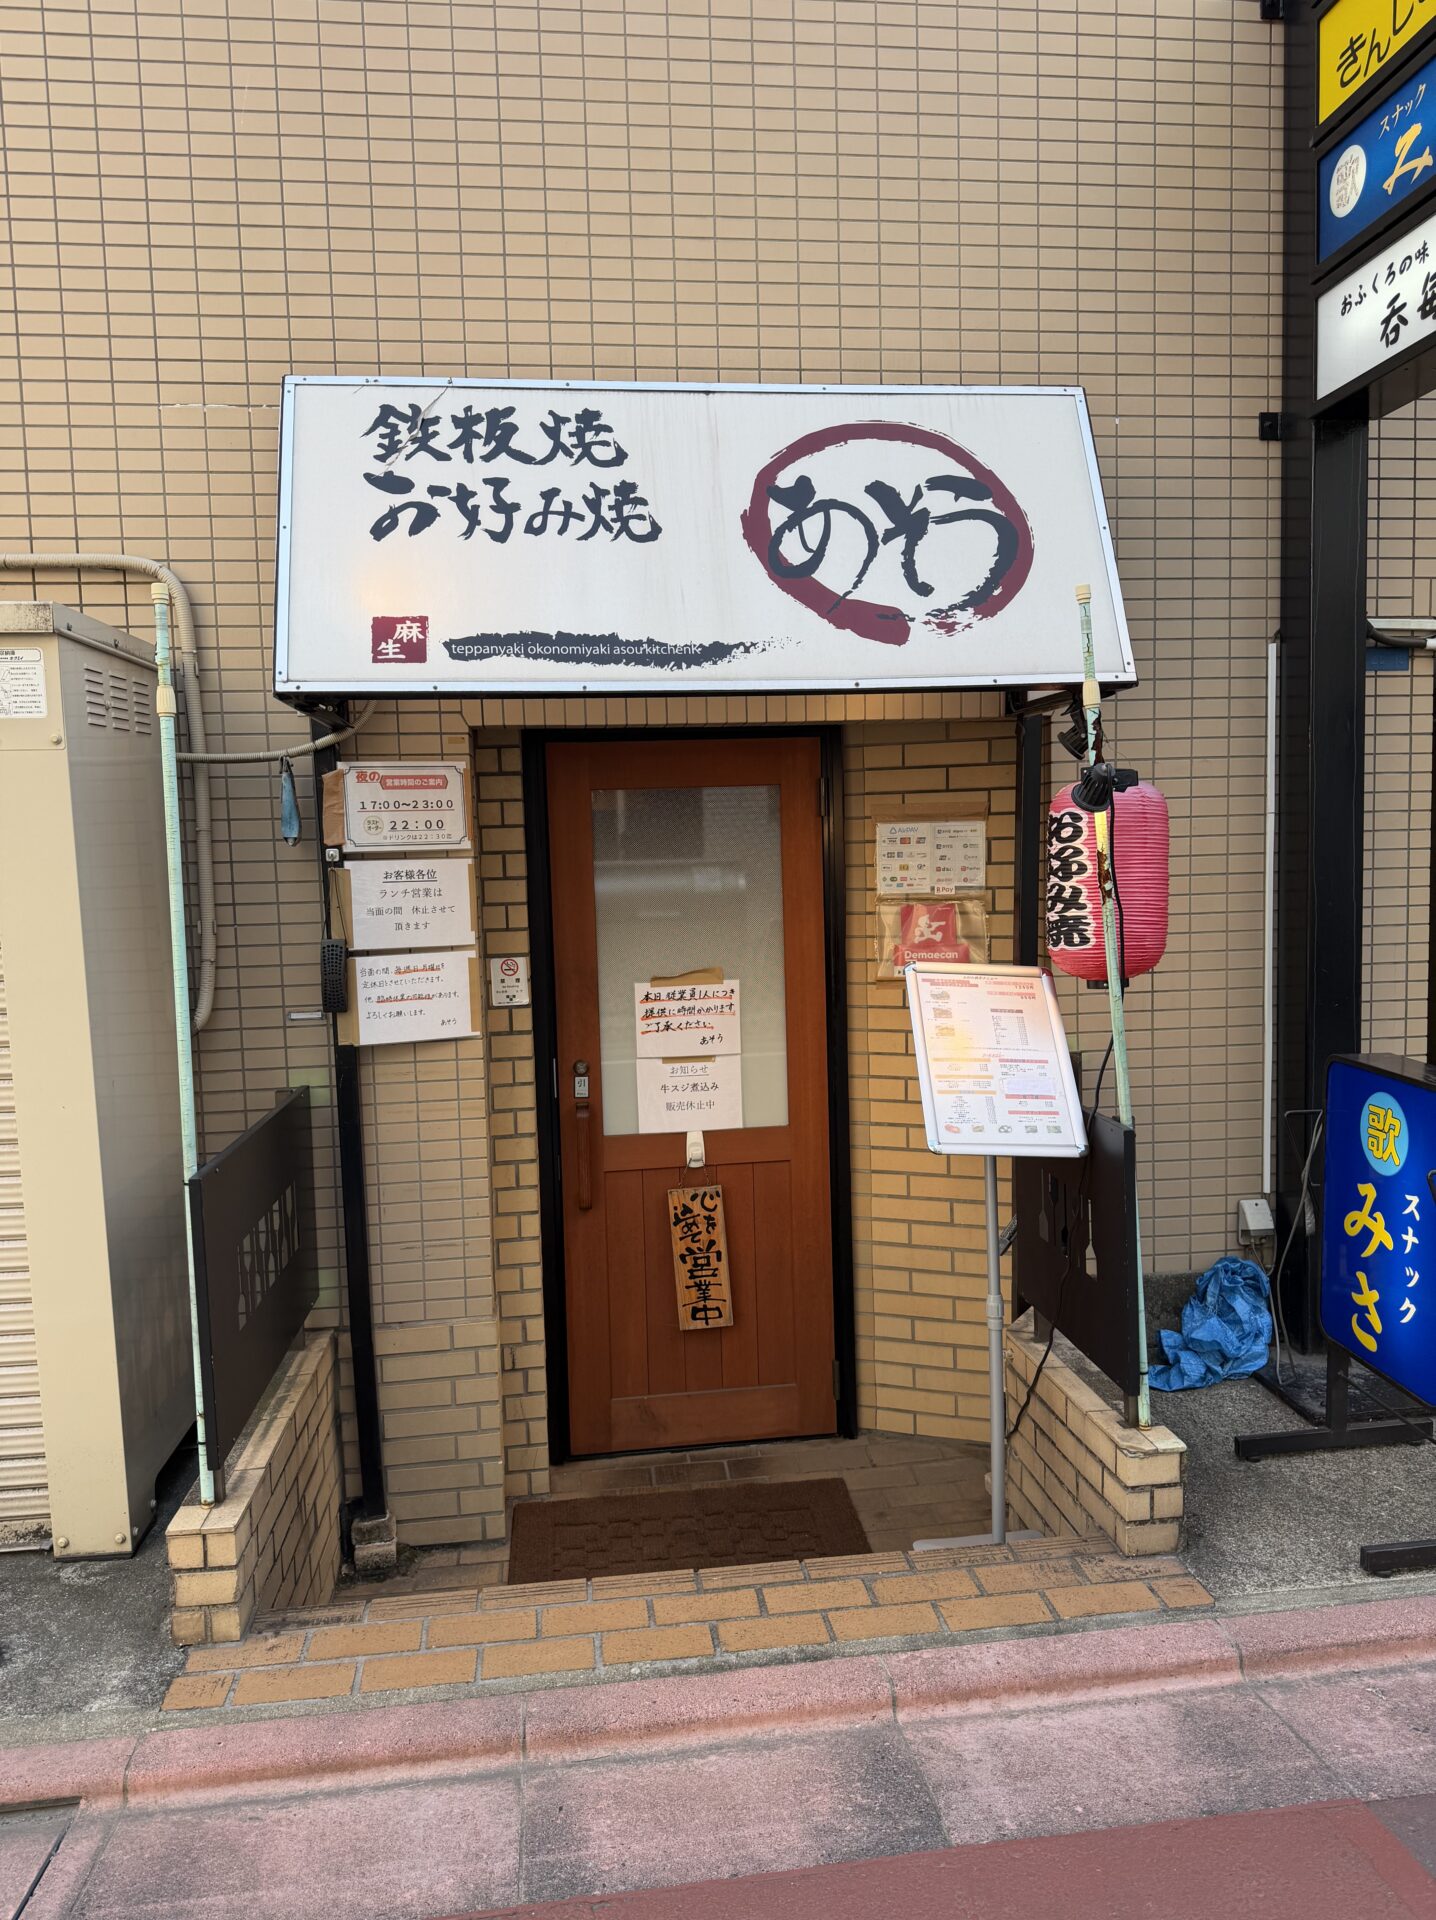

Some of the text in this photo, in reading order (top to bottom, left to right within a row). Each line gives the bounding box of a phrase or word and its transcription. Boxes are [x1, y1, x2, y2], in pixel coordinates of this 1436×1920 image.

[1378, 83, 1427, 140] スナック
[1340, 239, 1430, 317] おふくろの味
[360, 403, 629, 468] 鉄板焼
[362, 470, 663, 544] お好み焼
[765, 474, 1020, 618] あそう
[376, 620, 425, 661] 麻生
[451, 642, 525, 657] teppanyaki
[527, 642, 611, 657] okonomiyaki
[355, 770, 381, 784] 夜の
[383, 869, 438, 880] お客様各位
[378, 888, 443, 898] ランチ営業は
[366, 905, 456, 917] 当面の間 休止させて
[394, 922, 431, 931] 頂きます
[904, 950, 959, 959] Demaecan
[699, 1033, 724, 1046] あそう
[669, 1065, 710, 1075] お知らせ
[660, 1082, 719, 1094] 牛スジ煮込み
[665, 1100, 715, 1112] 販売休止中
[1367, 1103, 1401, 1166] 歌
[1399, 1194, 1420, 1324] スナック
[1343, 1182, 1394, 1353] みさ
[678, 1239, 727, 1326] 営業中
